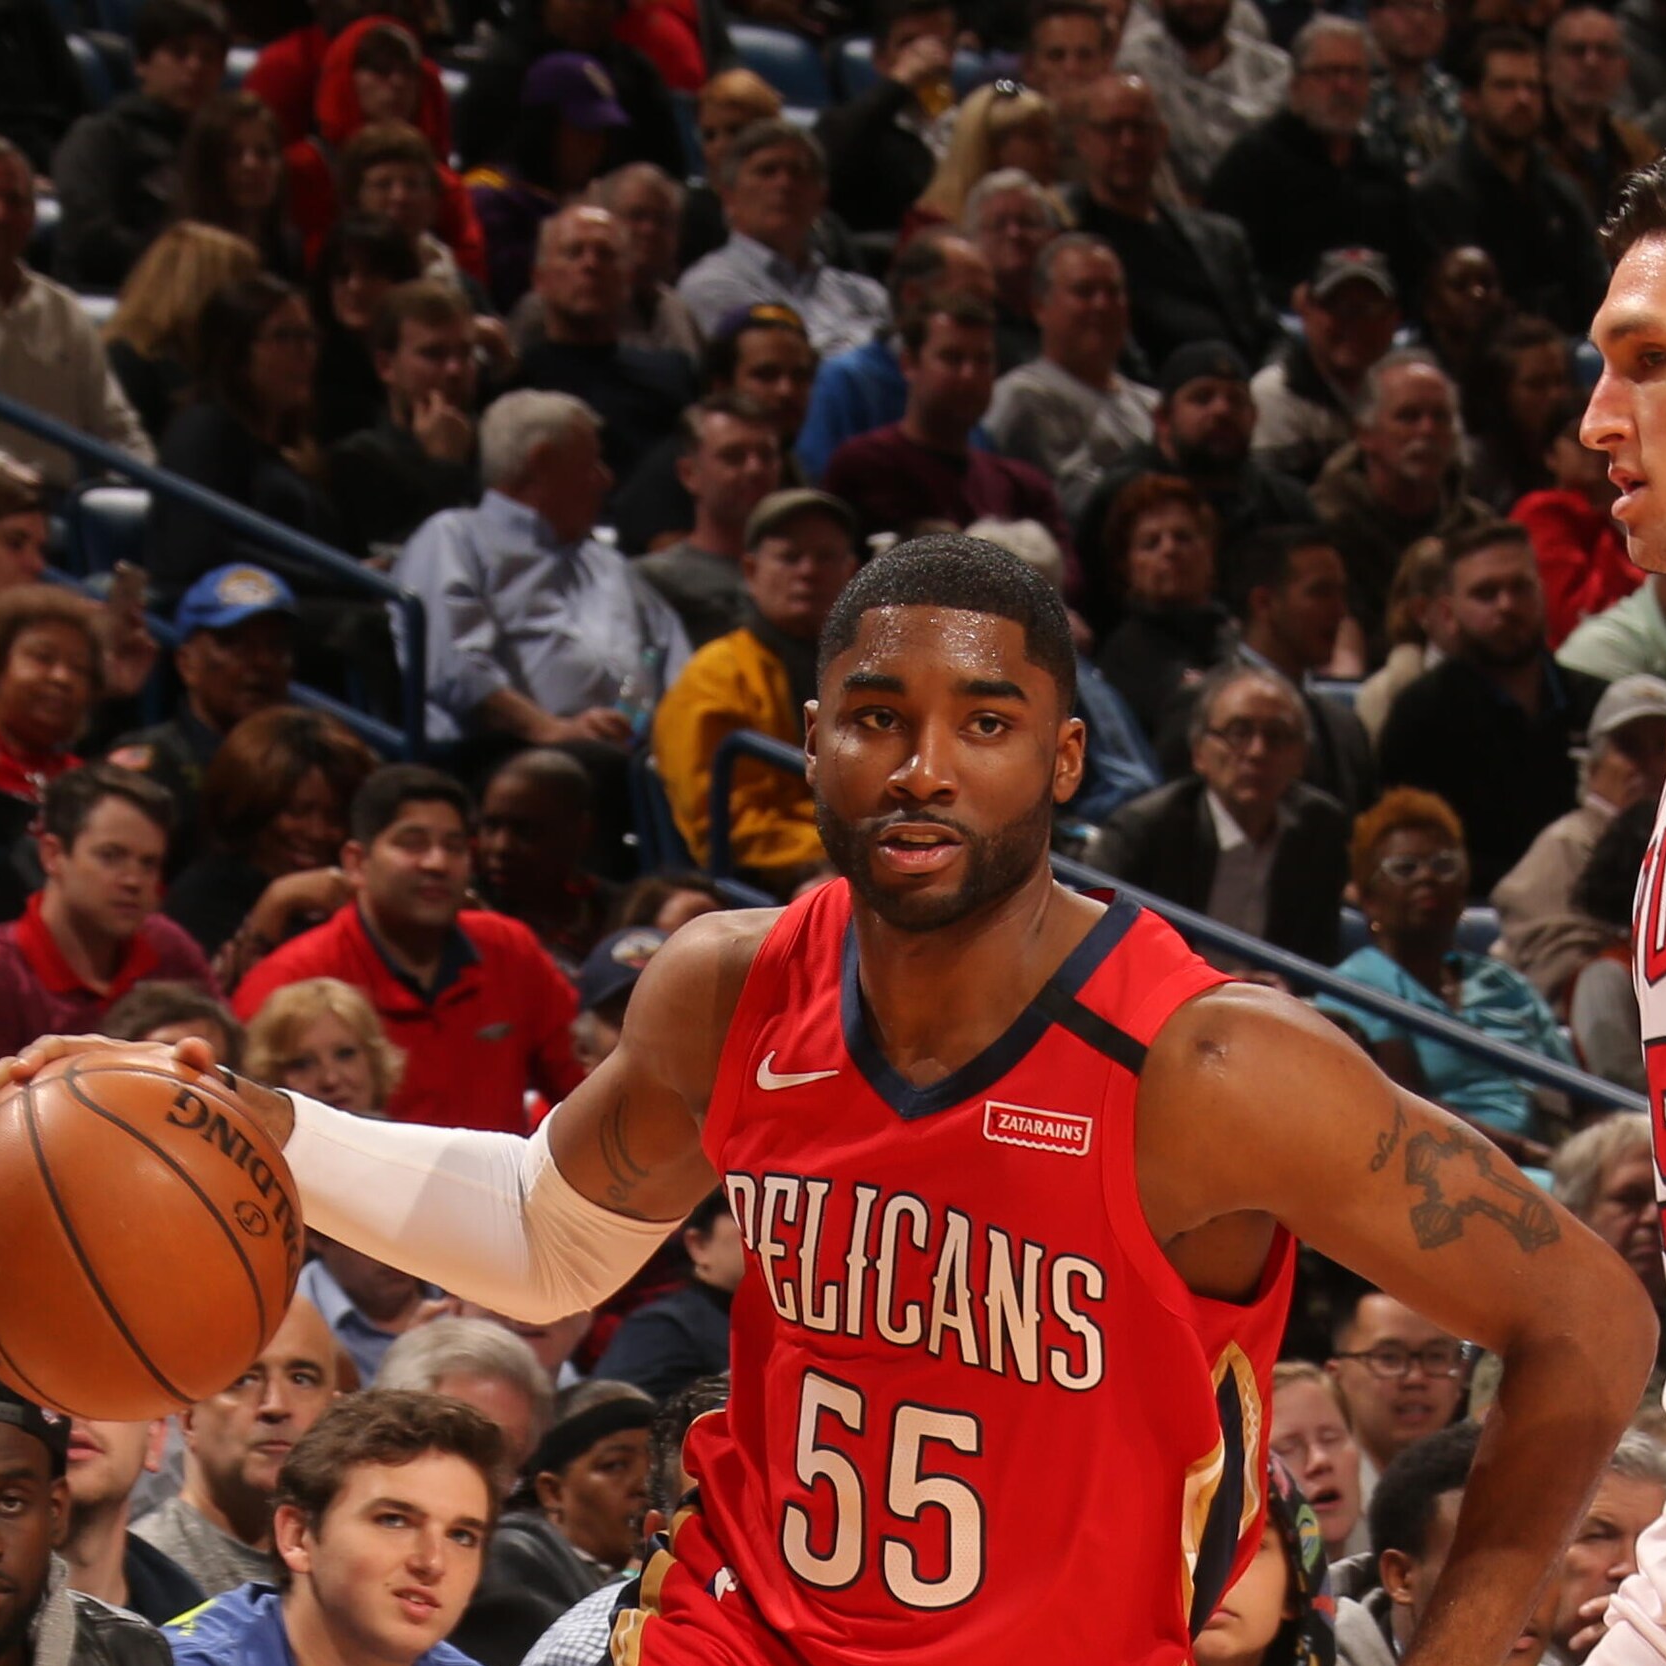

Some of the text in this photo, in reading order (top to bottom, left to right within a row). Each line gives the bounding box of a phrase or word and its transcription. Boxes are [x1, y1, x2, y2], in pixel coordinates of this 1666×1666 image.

[166, 1090, 300, 1302] PALDING
[997, 1112, 1084, 1143] ZATARAIN'S
[725, 1171, 1107, 1393] PELICANS
[782, 1367, 988, 1613] 55
